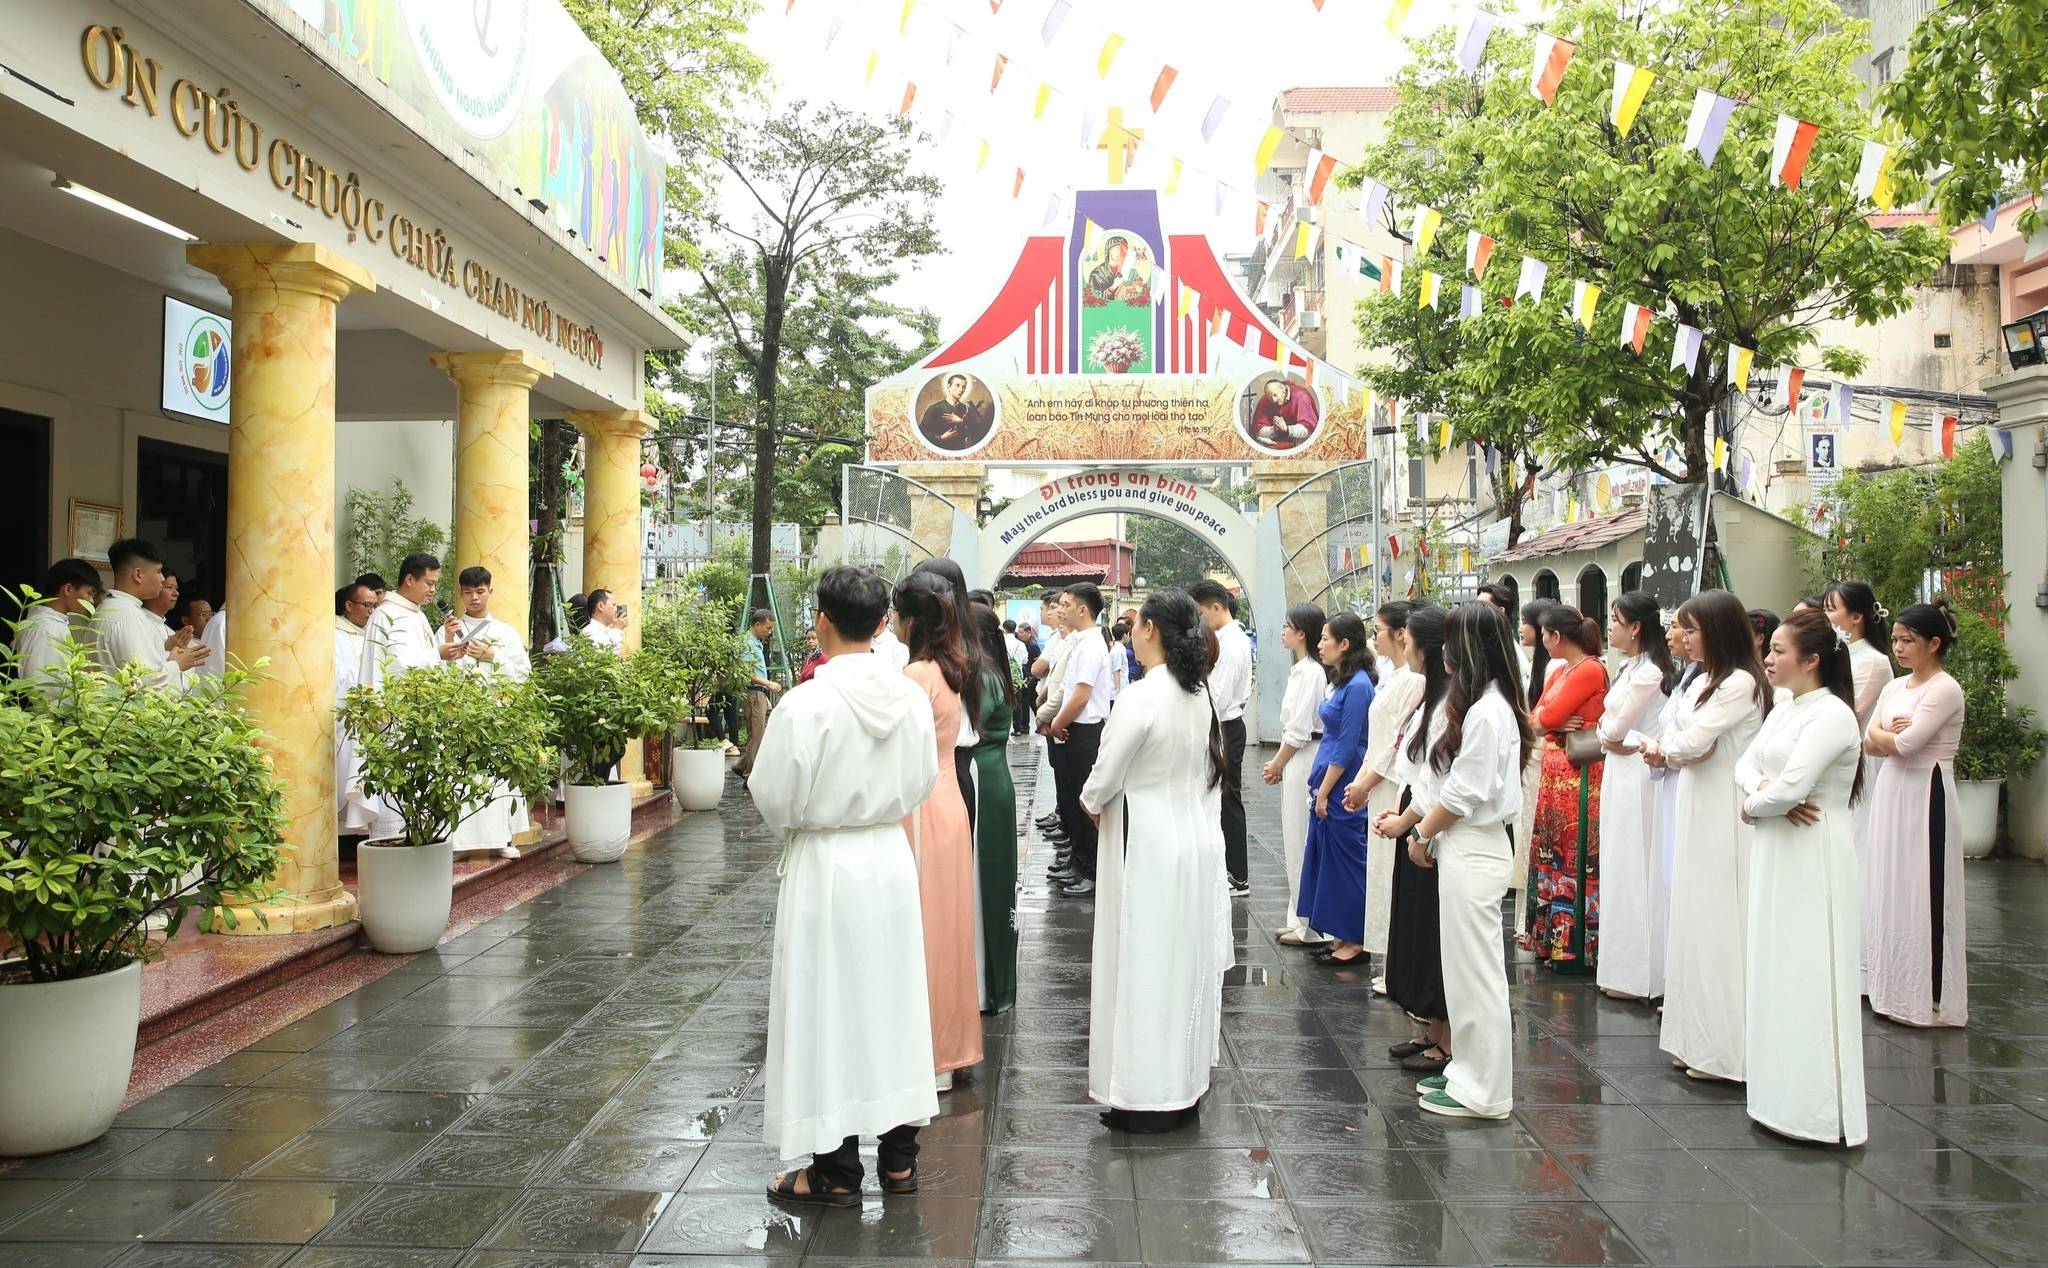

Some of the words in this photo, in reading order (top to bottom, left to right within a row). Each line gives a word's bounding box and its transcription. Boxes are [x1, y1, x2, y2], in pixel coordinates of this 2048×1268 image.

[82, 24, 164, 117] ƠN
[171, 79, 264, 171] CỨU
[269, 139, 385, 243] CHUỘC
[389, 214, 460, 288] CHỨA
[463, 259, 519, 322] CHAN
[556, 314, 604, 370] NGƯỜI
[1026, 412, 1046, 421] loan
[1048, 411, 1067, 421] báo
[1112, 412, 1130, 421] cho
[1064, 398, 1082, 410] hãy
[1084, 399, 1093, 408] đi
[1067, 472, 1120, 489] trong
[1127, 472, 1150, 486] an
[1156, 474, 1197, 501] bình
[1000, 522, 1026, 544] May
[1023, 511, 1043, 526] the
[1040, 496, 1067, 516] Lord
[1067, 489, 1098, 505] bless
[1100, 488, 1122, 500] you
[1125, 488, 1147, 499] and
[1149, 490, 1174, 506] give
[1175, 500, 1197, 516] you
[1195, 510, 1226, 536] peace
